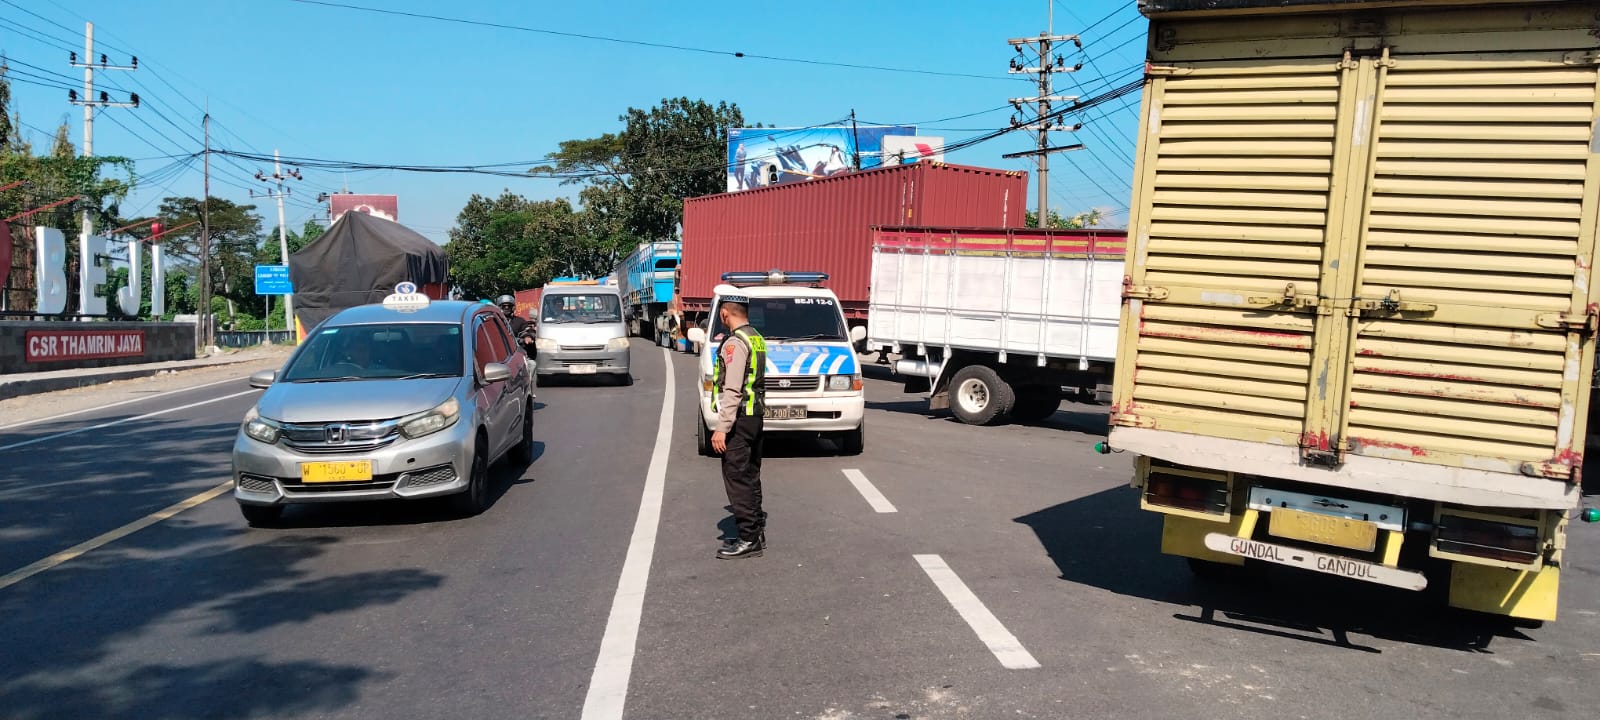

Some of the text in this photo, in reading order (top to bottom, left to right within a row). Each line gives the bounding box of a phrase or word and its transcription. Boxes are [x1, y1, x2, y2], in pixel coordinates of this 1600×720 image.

[29, 334, 142, 357] CSR THAMRIN JAYA
[303, 463, 310, 476] W
[1230, 539, 1285, 562] GUNDAL
[1317, 556, 1378, 579] GANDUL
